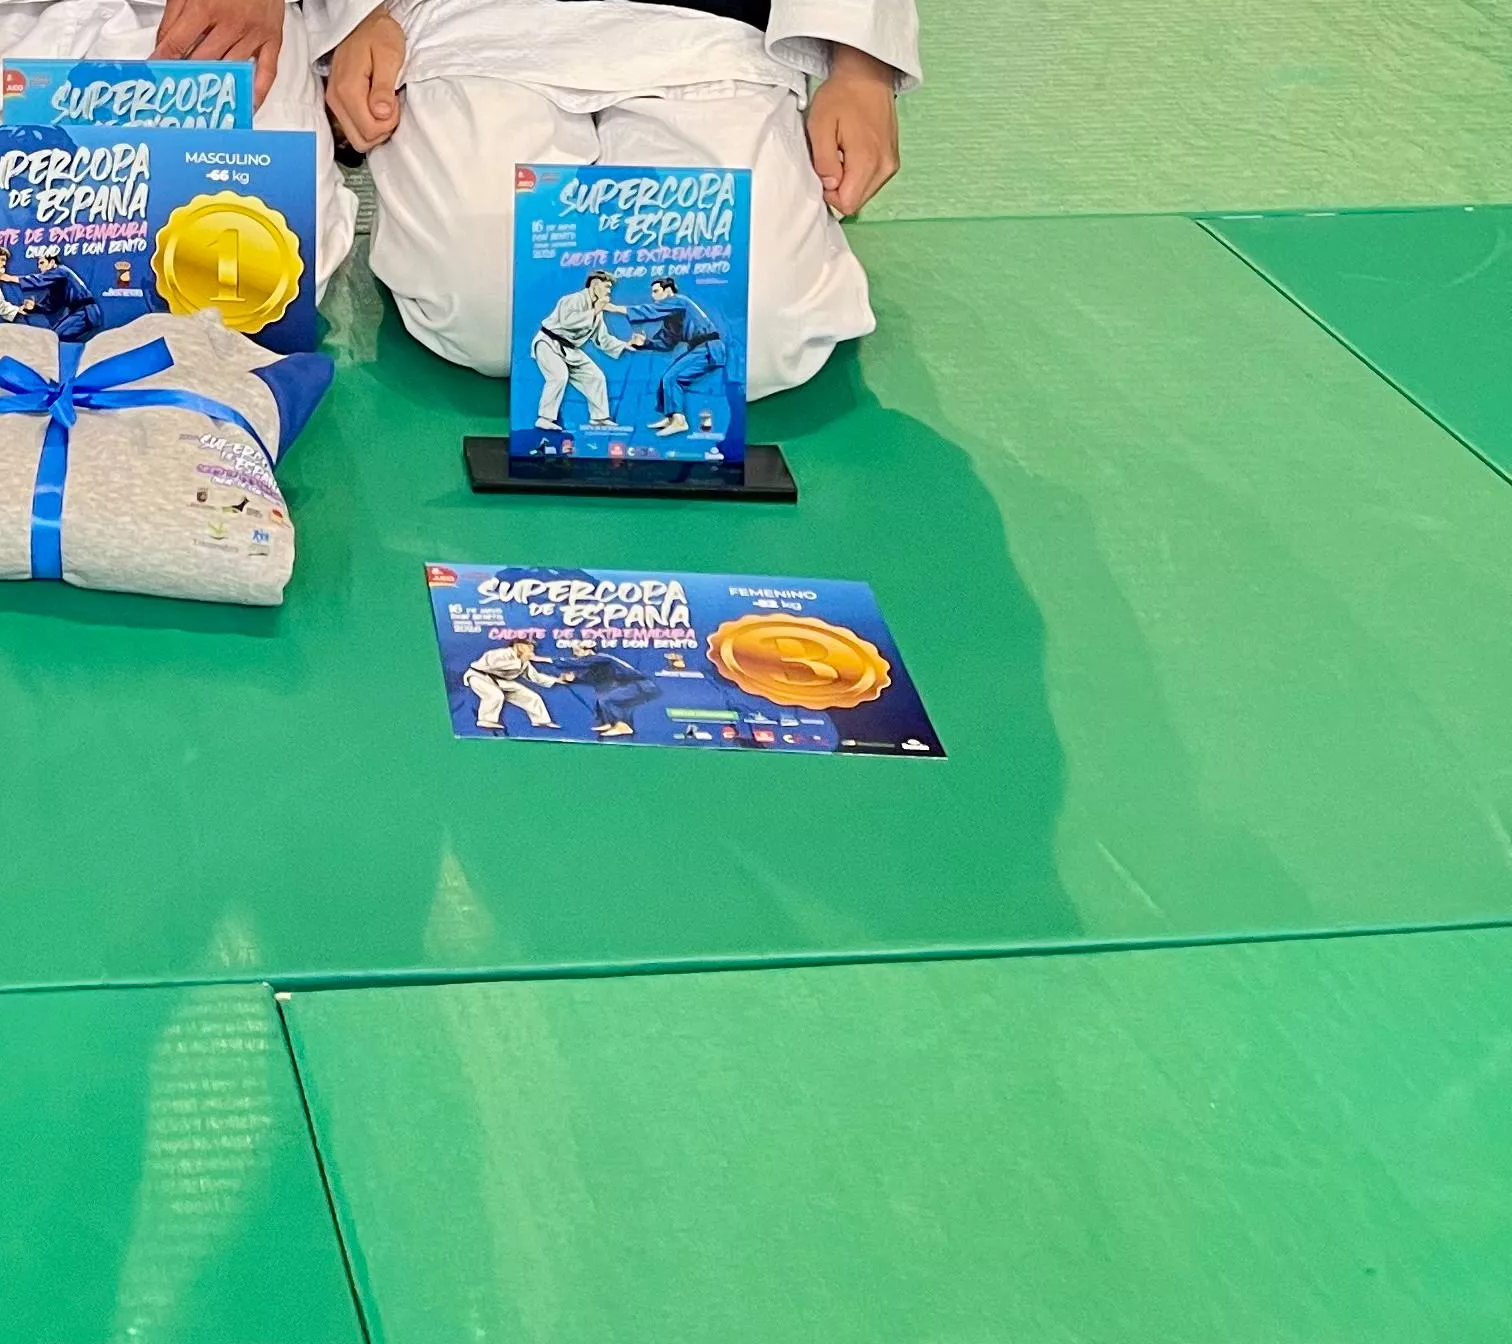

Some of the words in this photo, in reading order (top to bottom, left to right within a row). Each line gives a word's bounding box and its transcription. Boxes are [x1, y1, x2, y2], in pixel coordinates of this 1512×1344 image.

[50, 72, 236, 124] SUPERCOPA
[185, 151, 271, 167] MASCULINO
[232, 169, 250, 185] kg
[8, 188, 33, 209] DE
[558, 173, 736, 217] SUPERCOPA
[24, 227, 45, 244] DE
[48, 221, 148, 242] EXTREMADURA
[599, 213, 623, 232] DE
[208, 227, 247, 302] 1
[477, 577, 688, 605] SUPERCOPA
[728, 586, 818, 600] FEMENINO
[529, 602, 556, 617] DE
